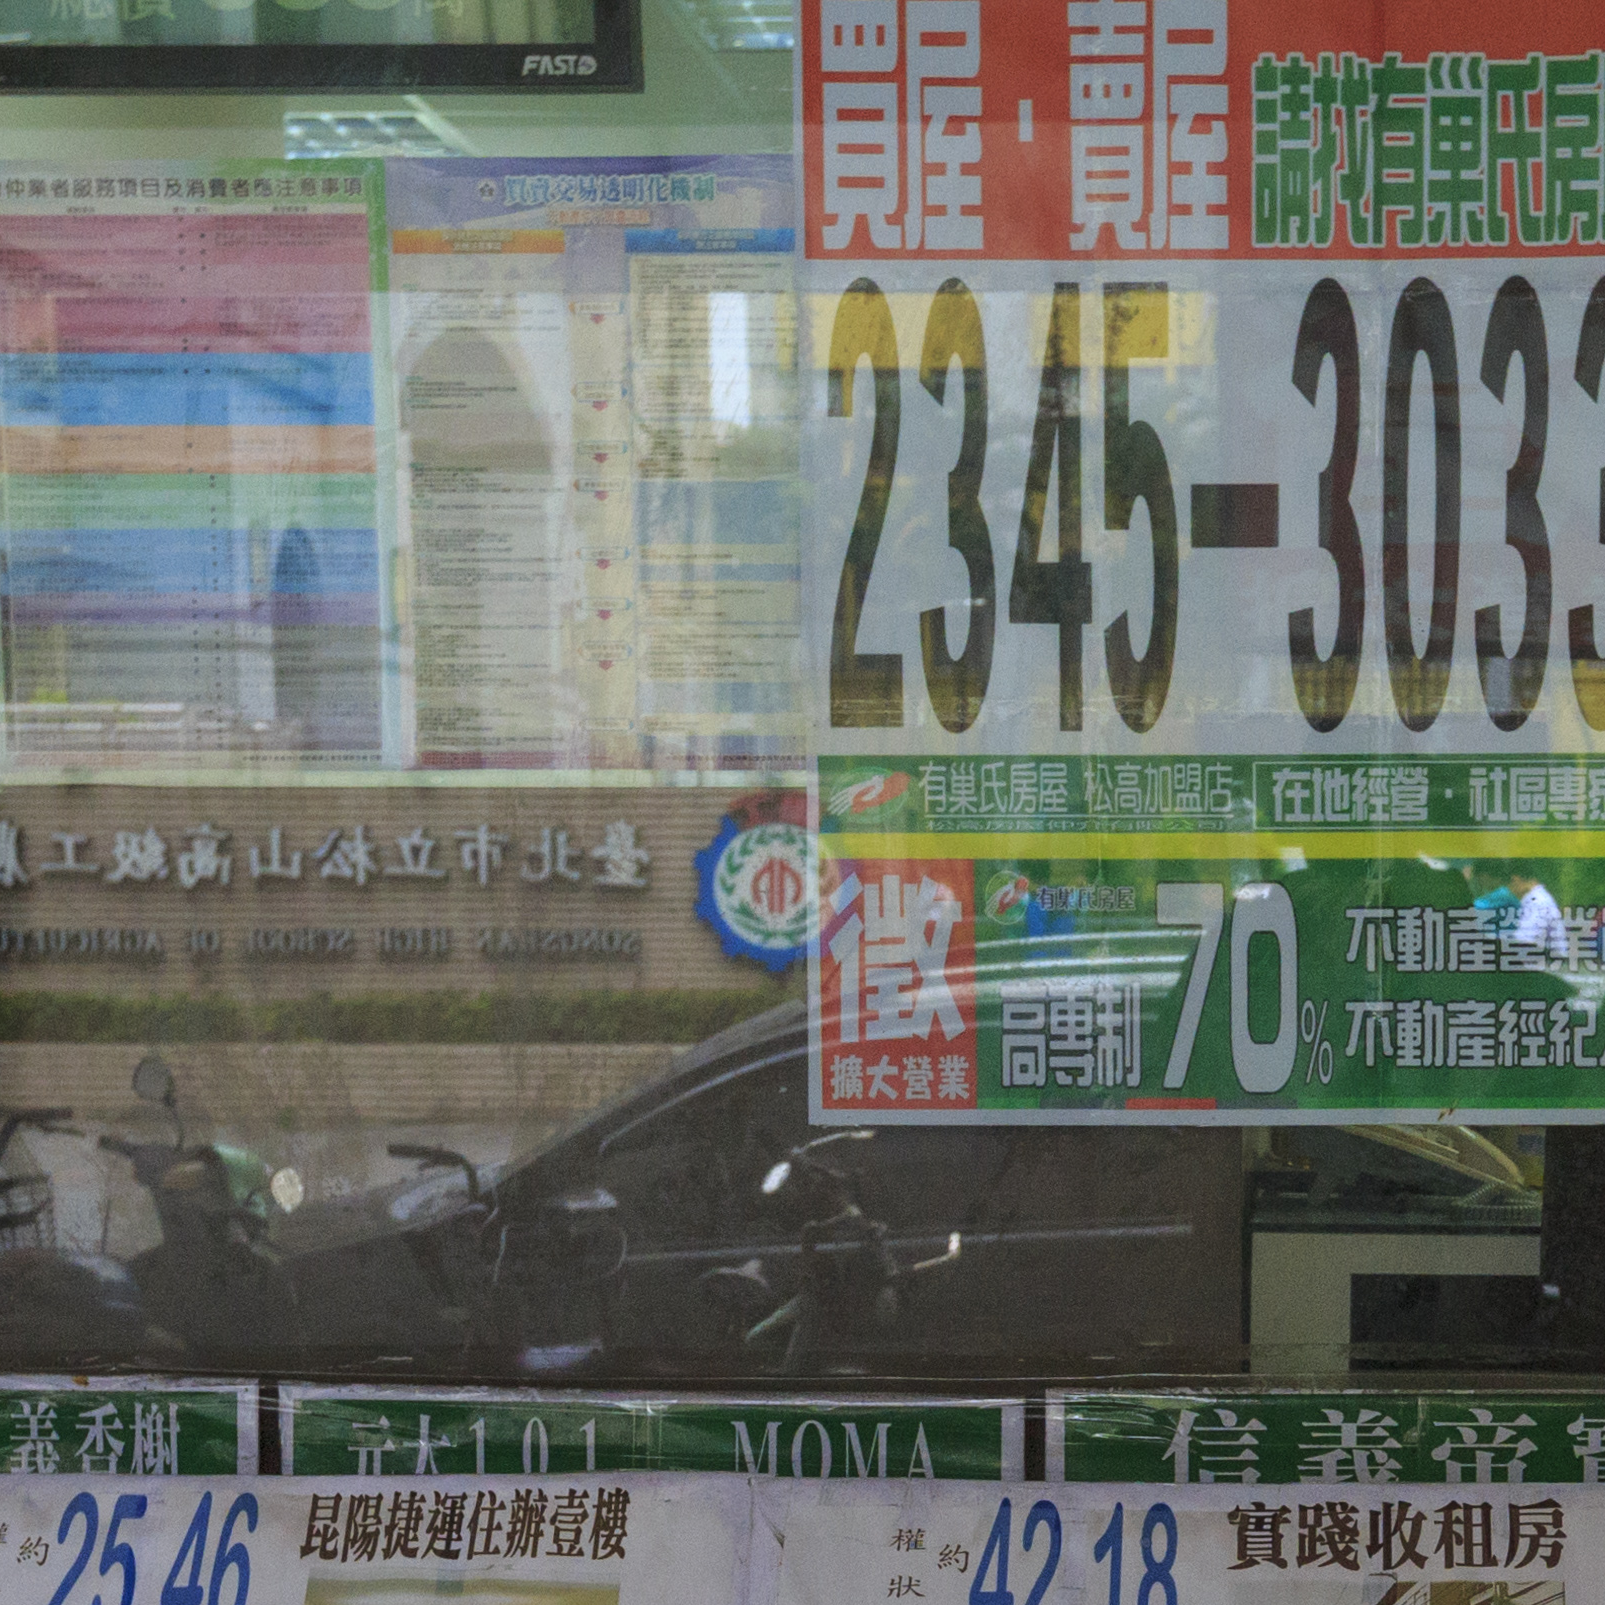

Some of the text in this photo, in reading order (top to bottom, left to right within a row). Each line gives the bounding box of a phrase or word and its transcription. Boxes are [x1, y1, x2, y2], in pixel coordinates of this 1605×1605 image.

[919, 761, 1233, 814] 有巢氏房屋 松高加盟店
[1000, 983, 1142, 1090] 高專制
[829, 1054, 972, 1102] 擴大營業
[16, 1534, 50, 1567] 約
[300, 1490, 631, 1562] 昆陽捷運住辦壹樓
[1227, 1499, 1567, 1571] 實踐收租房
[937, 1541, 970, 1573] 約
